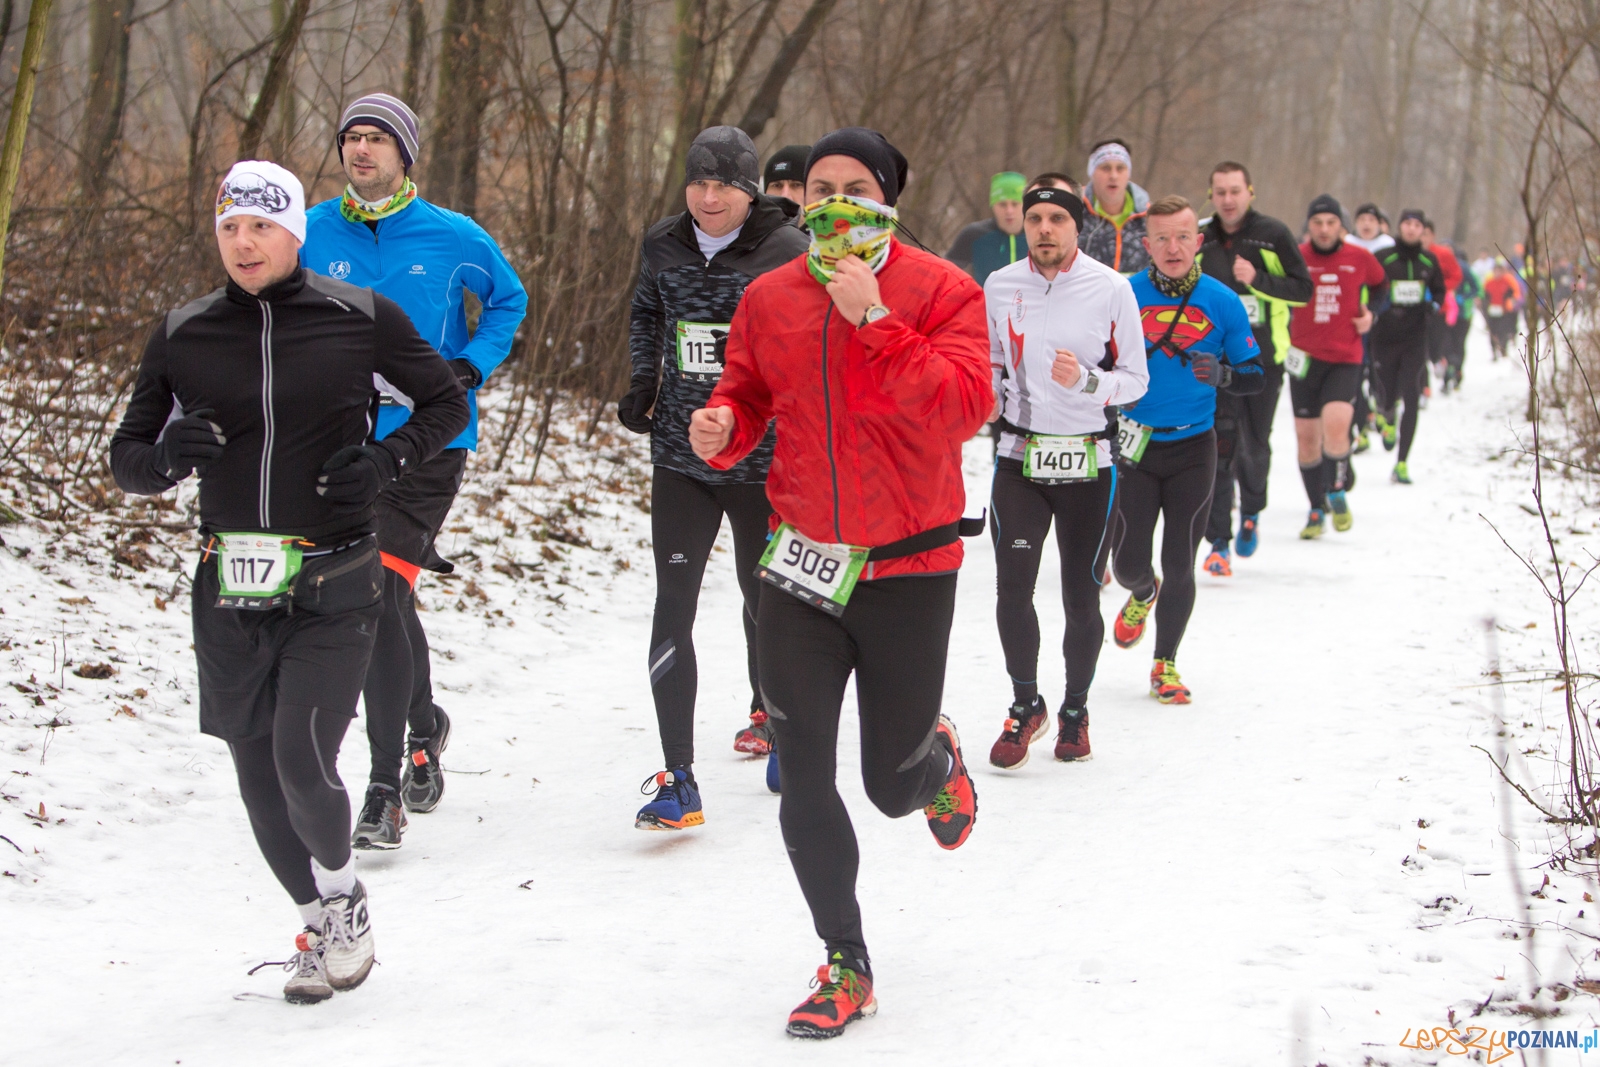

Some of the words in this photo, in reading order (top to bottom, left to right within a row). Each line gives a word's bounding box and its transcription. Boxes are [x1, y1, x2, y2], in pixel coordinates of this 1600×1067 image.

[686, 341, 717, 364] 113
[1035, 451, 1086, 470] 1407
[230, 557, 275, 584] 1717
[783, 539, 840, 584] 908
[794, 573, 813, 586] RUFA
